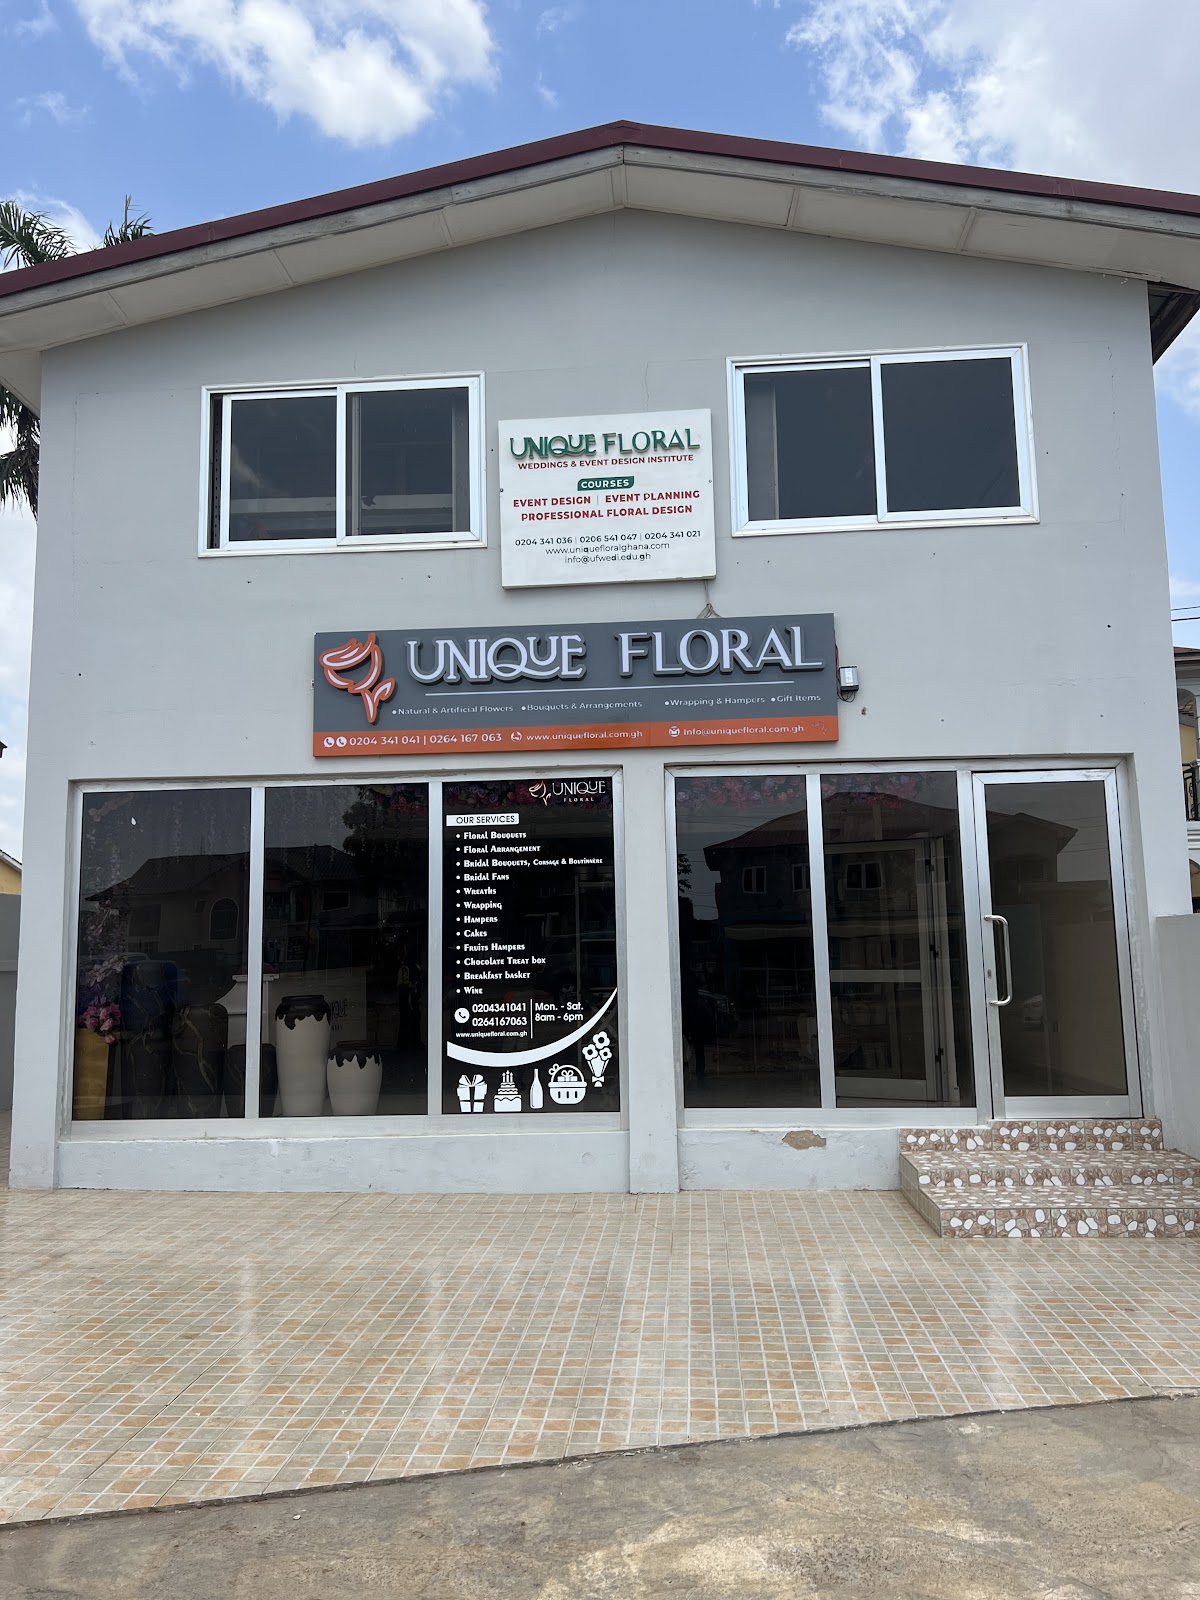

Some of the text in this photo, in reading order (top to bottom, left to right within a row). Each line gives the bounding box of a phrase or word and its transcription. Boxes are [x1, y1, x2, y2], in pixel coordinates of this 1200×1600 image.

[510, 428, 700, 460] UNIQUE FLORAL
[518, 461, 568, 470] WEDDINGS
[579, 459, 608, 468] EVENT
[612, 457, 645, 466] DESIGN
[648, 454, 694, 464] INSTITUTE
[581, 478, 630, 489] COURSES
[513, 498, 548, 508] EVENT
[551, 496, 591, 506] DESIGN
[605, 494, 640, 503] EVENT
[644, 490, 700, 501] PLANNING
[522, 505, 693, 522] PROFESSIONAL FLORAL DESIGN
[515, 538, 537, 546] 0204
[540, 538, 554, 546] 341
[556, 536, 573, 544] 036
[579, 535, 602, 543] 0206
[604, 534, 618, 542] 541
[620, 534, 637, 542] 047
[644, 532, 668, 540] 0204
[670, 530, 684, 539] 341
[686, 530, 702, 538] 021
[546, 542, 670, 555] www.uniquefloralghana.com
[564, 552, 652, 564] info@ufwedi.edu.gh
[406, 625, 824, 681] UNIQUE FLORAL
[670, 698, 714, 708] Wrapping
[725, 696, 765, 706] Hampers
[777, 694, 793, 702] Gift
[440, 706, 478, 714] Artificial
[480, 704, 514, 712] Flowers
[528, 704, 569, 712] Bouquets
[580, 702, 642, 711] Arrangements
[350, 737, 378, 746] 0204
[381, 736, 398, 744] 341
[402, 736, 420, 744] 041
[430, 734, 458, 744] 0264
[461, 734, 478, 742] 167
[482, 734, 502, 742] 063
[526, 730, 642, 742] www.uniquefloral.com.gh
[552, 780, 606, 796] UNIQUE
[456, 816, 474, 824] OUR
[472, 1003, 526, 1012] 0204341041
[534, 1002, 558, 1011] Mon.
[566, 1002, 584, 1011] Sat.
[472, 1016, 528, 1026] 0264167063
[534, 1013, 556, 1022] 8am
[563, 1012, 584, 1022] 6pm
[456, 1030, 528, 1039] www.uniquefloral.com.gh
